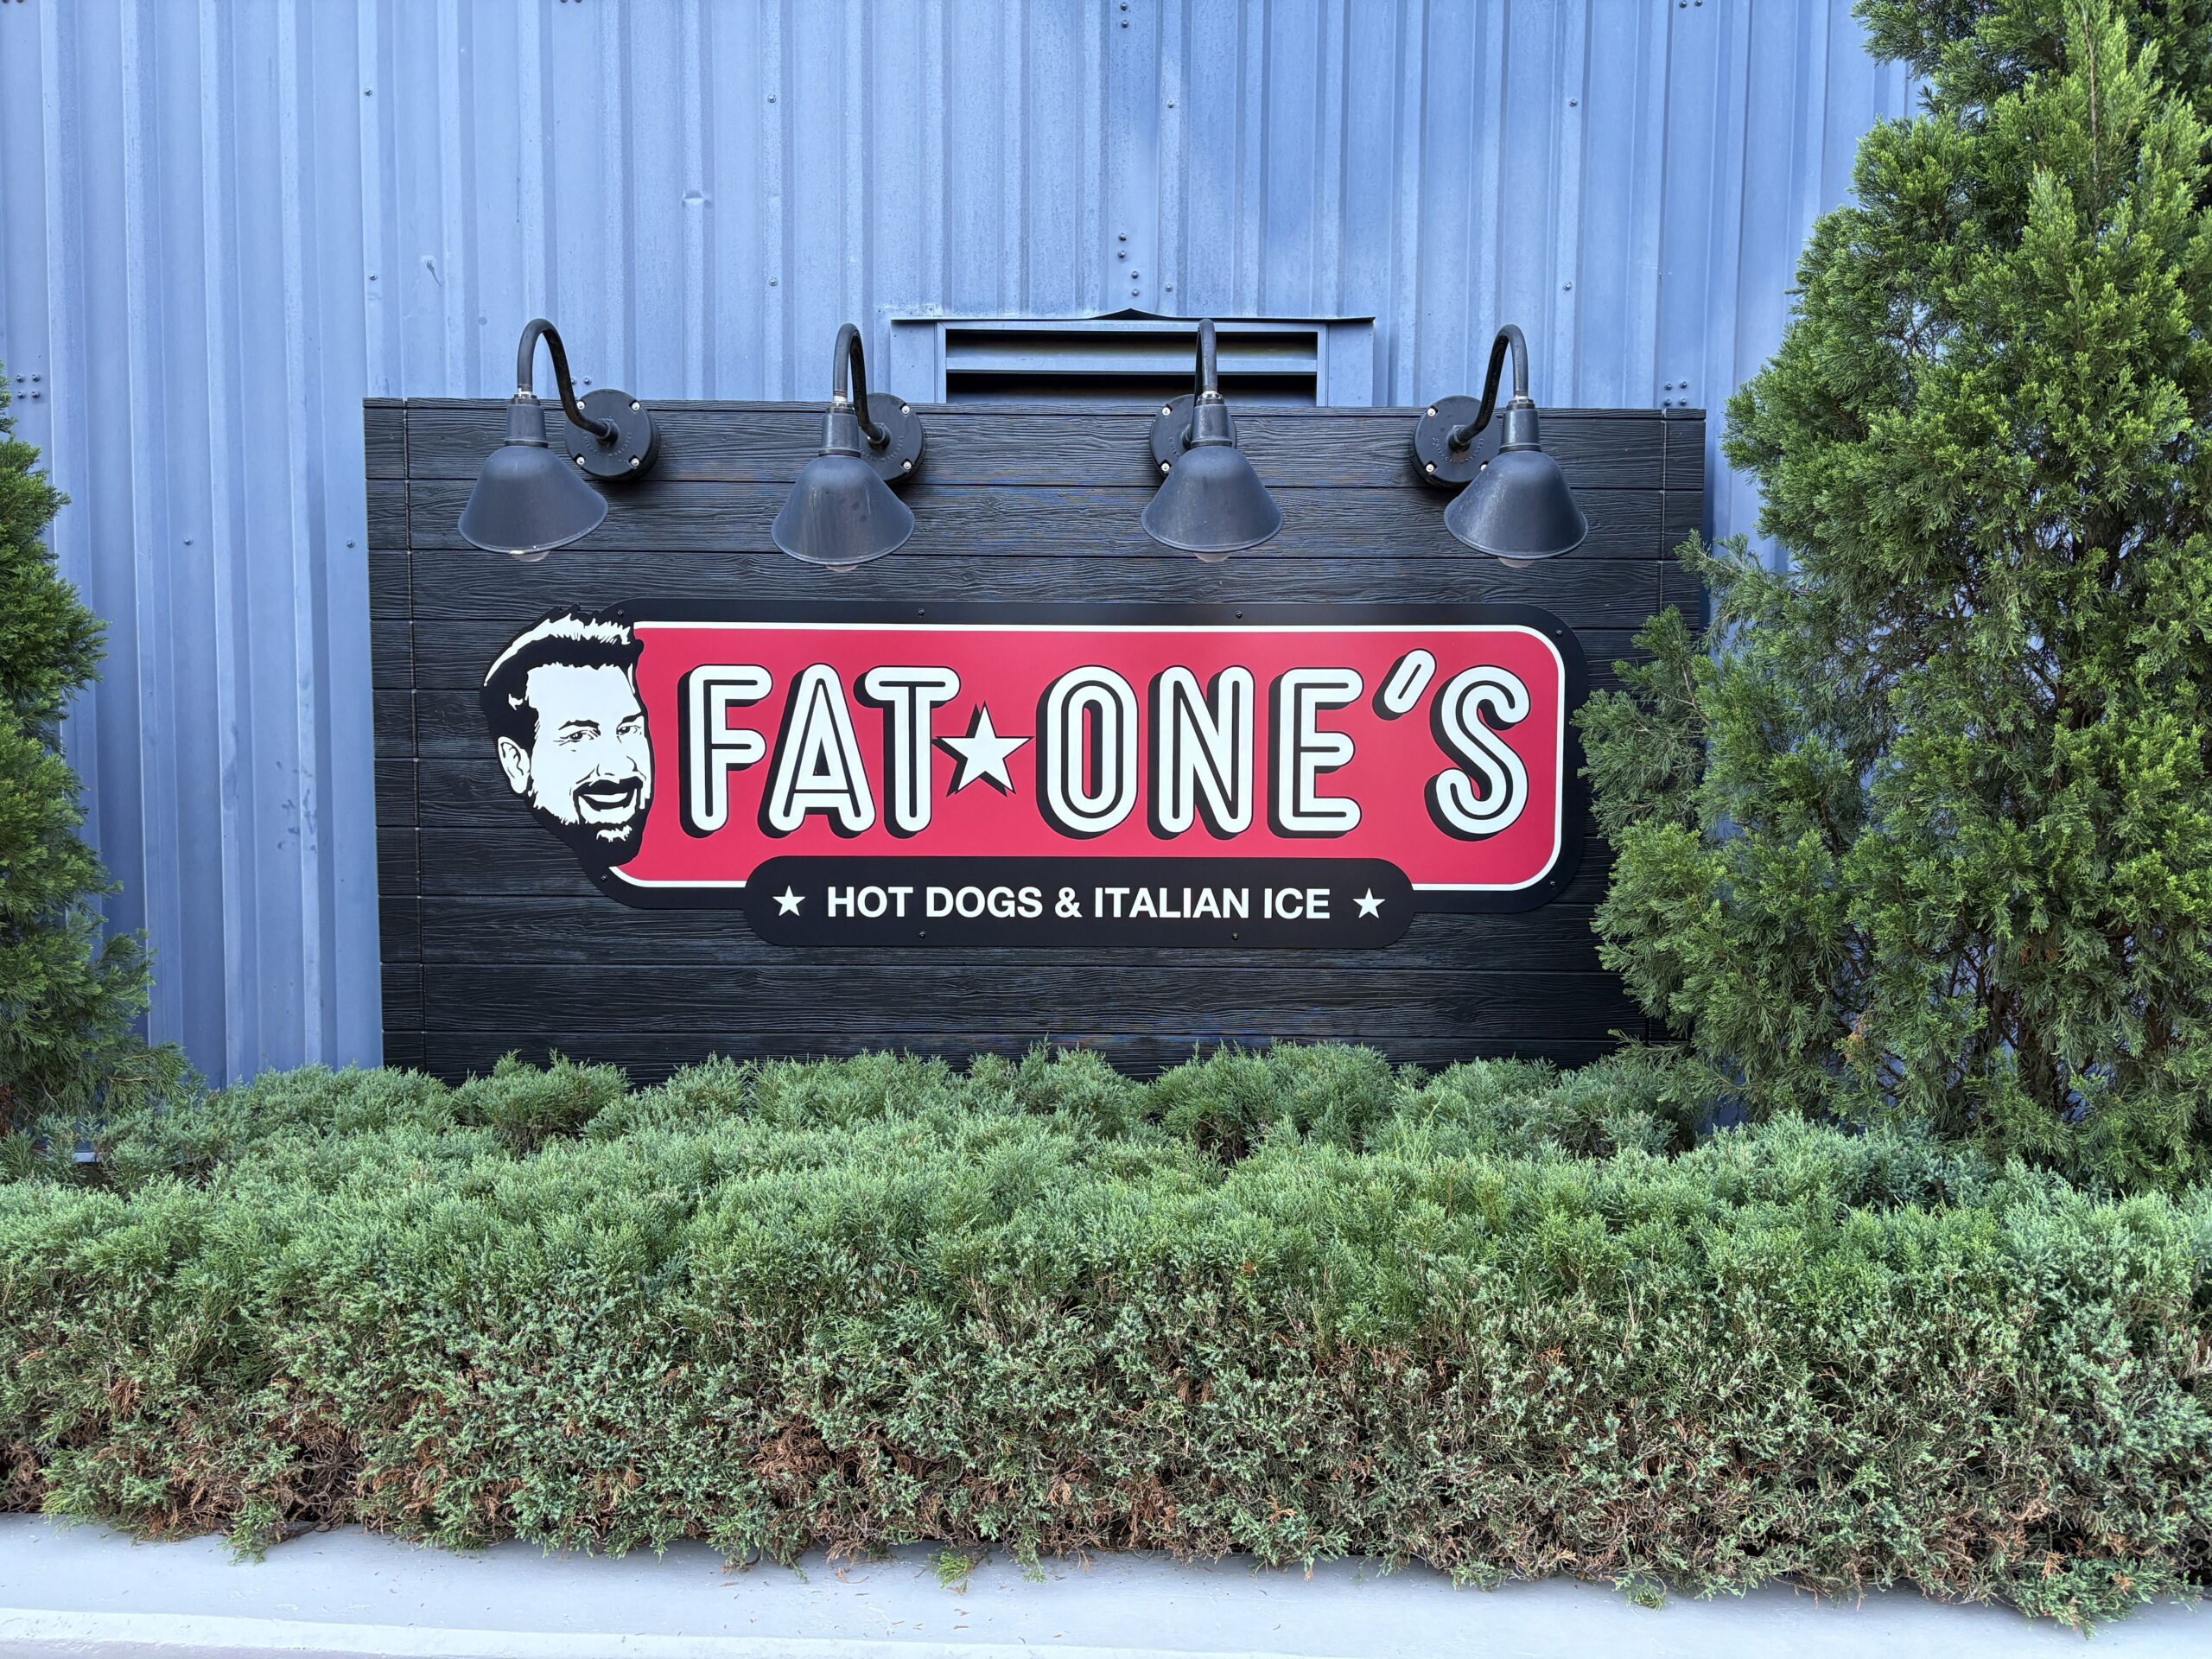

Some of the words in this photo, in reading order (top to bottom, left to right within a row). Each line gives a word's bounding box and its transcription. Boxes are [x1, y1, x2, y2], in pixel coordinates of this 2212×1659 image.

[680, 664, 961, 836] FAT
[1039, 650, 1530, 836] ONE'S
[828, 886, 914, 918] HOT
[926, 886, 1043, 918] DOGS
[1054, 887, 1084, 918] &
[1095, 887, 1249, 918] ITALIAN
[1263, 887, 1332, 919] ICE
